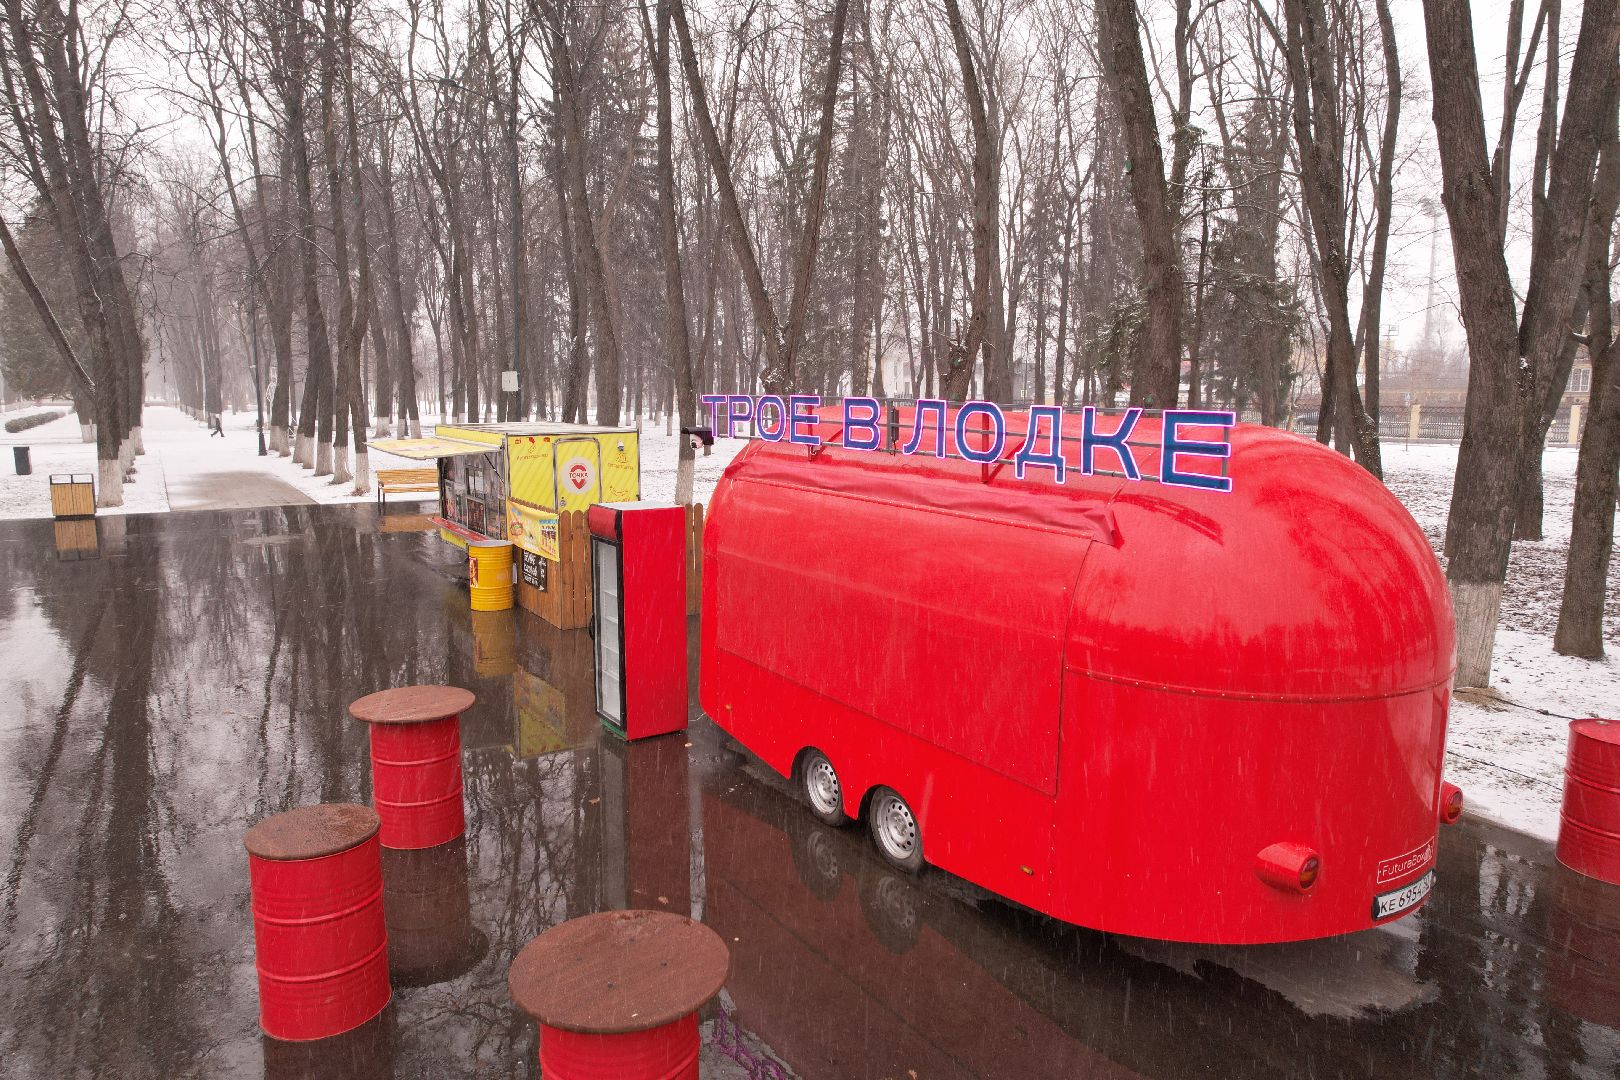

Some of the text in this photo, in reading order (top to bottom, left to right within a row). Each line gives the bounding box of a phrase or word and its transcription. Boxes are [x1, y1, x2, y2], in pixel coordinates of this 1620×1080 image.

[701, 394, 1237, 493] ТРОЕ В ЛОДКЕ
